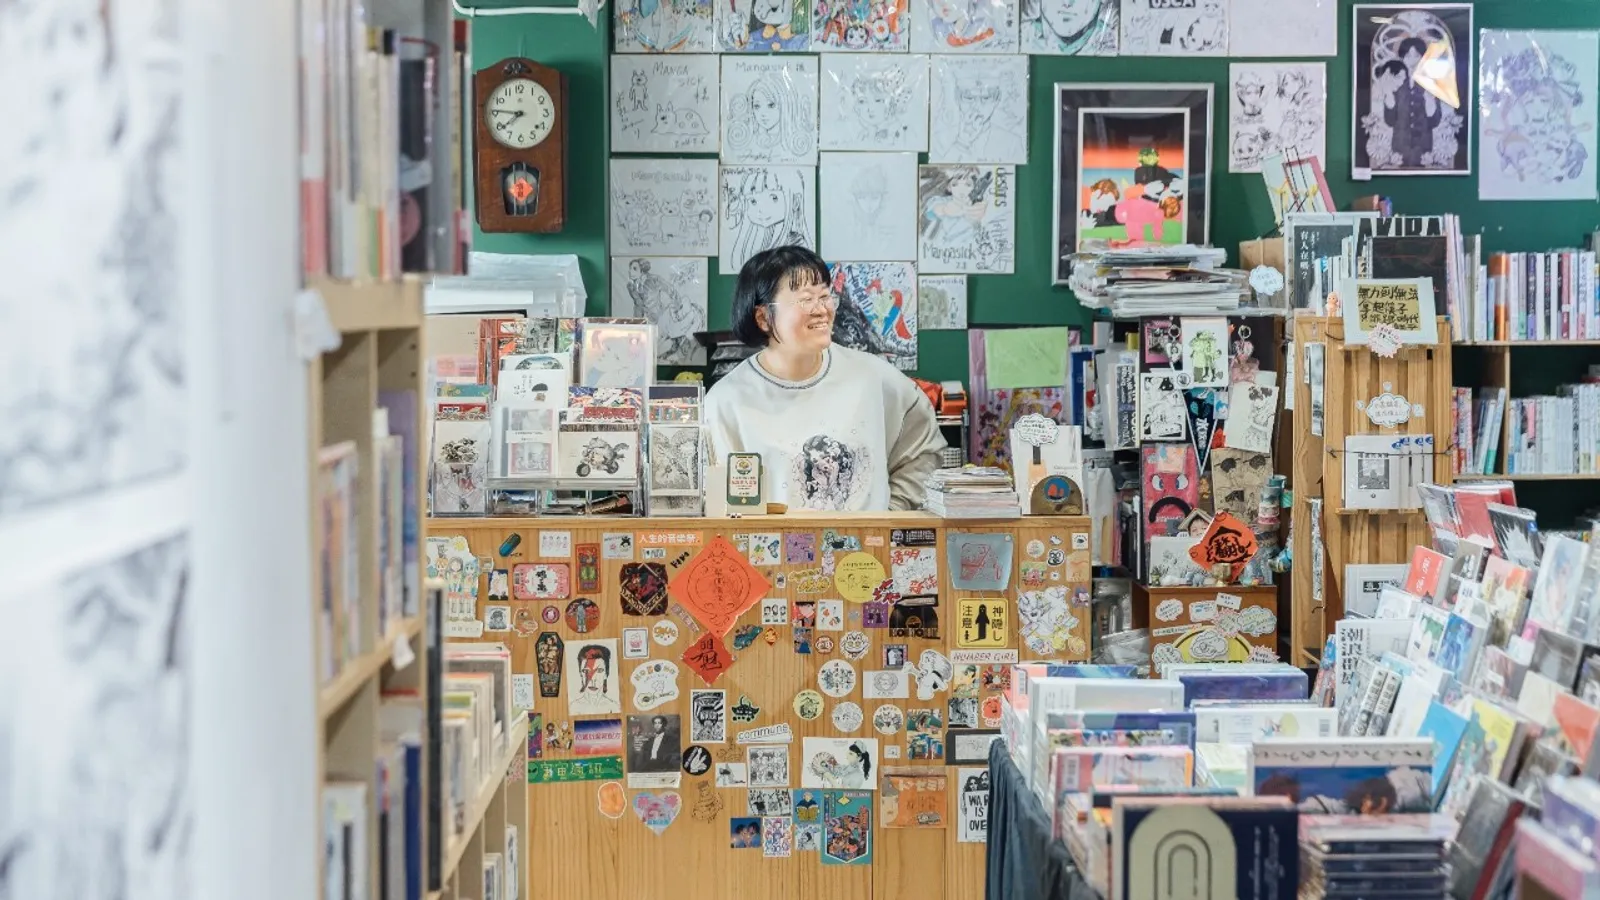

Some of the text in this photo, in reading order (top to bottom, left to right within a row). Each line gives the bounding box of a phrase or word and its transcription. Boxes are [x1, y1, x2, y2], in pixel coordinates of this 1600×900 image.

[961, 605, 973, 629] 注意
[953, 651, 1015, 662] NUMBER GIRL
[738, 724, 789, 741] commune
[975, 807, 985, 817] IS
[969, 819, 988, 831] OVE
